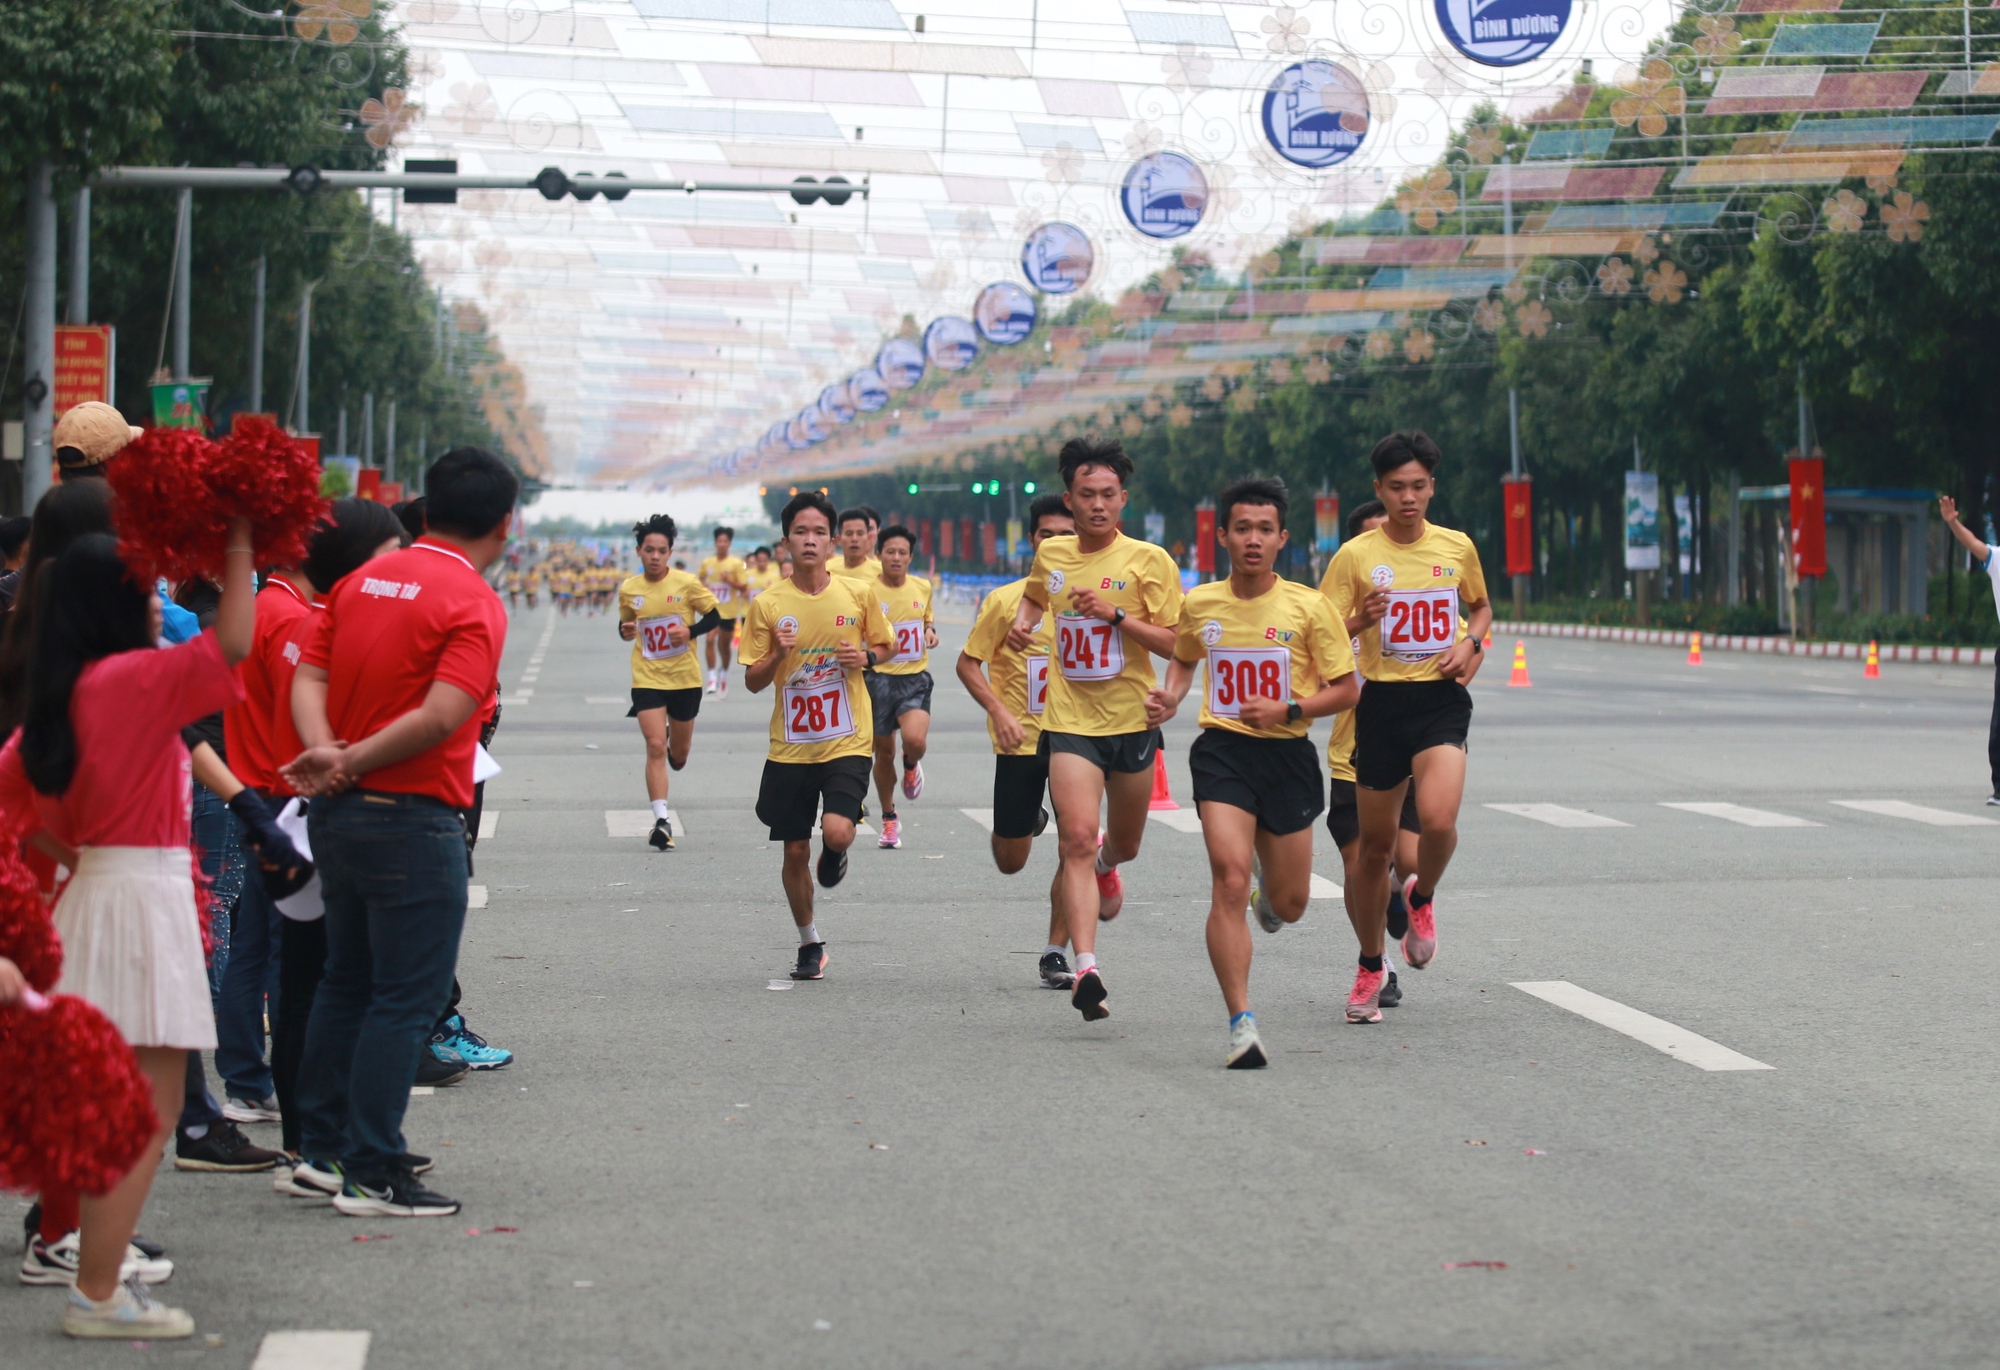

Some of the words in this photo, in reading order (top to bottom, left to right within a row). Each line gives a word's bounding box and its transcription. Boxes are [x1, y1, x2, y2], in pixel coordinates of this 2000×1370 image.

[1474, 16, 1509, 39] BÌNH
[1511, 13, 1560, 36] DƯƠNG
[1100, 577, 1126, 590] BTV
[1432, 566, 1454, 577] BTV
[360, 577, 402, 599] TRỌNG
[835, 615, 856, 627] BTV
[1389, 599, 1451, 644] 205
[644, 622, 678, 653] 32
[898, 626, 920, 654] 21
[1061, 625, 1113, 669] 247
[1265, 627, 1293, 642] BTV
[801, 657, 838, 674] Number
[1217, 659, 1282, 706] 308
[791, 689, 841, 733] 287
